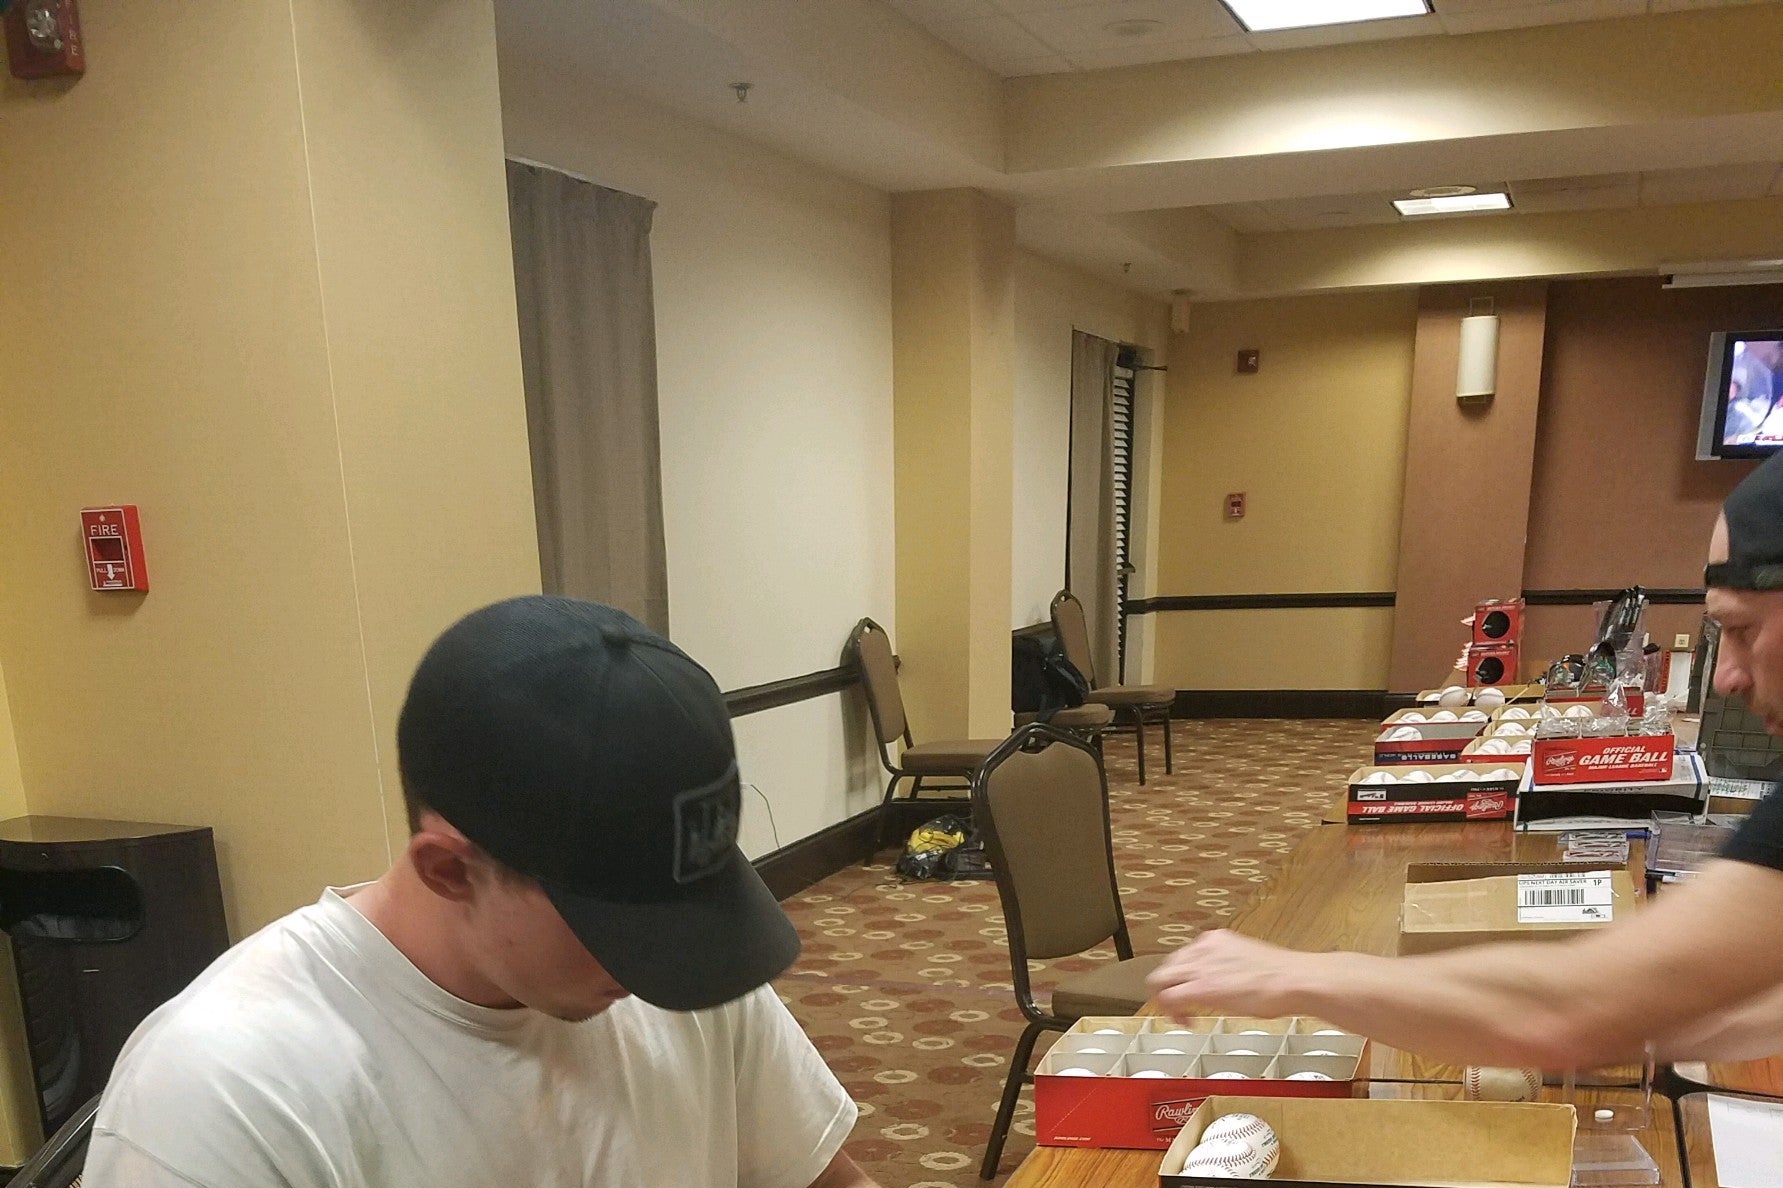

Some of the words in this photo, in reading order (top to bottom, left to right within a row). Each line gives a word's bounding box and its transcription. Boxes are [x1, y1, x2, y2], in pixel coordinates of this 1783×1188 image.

[90, 524, 119, 536] FIRE
[1602, 745, 1646, 755] OFFICIAL
[1579, 754, 1624, 766] GAME
[1628, 751, 1668, 763] BALL
[1362, 806, 1386, 814] BALL
[1387, 805, 1417, 813] GAME
[1420, 803, 1465, 812] OFFICIAL
[1155, 1102, 1199, 1121] Rawlin
